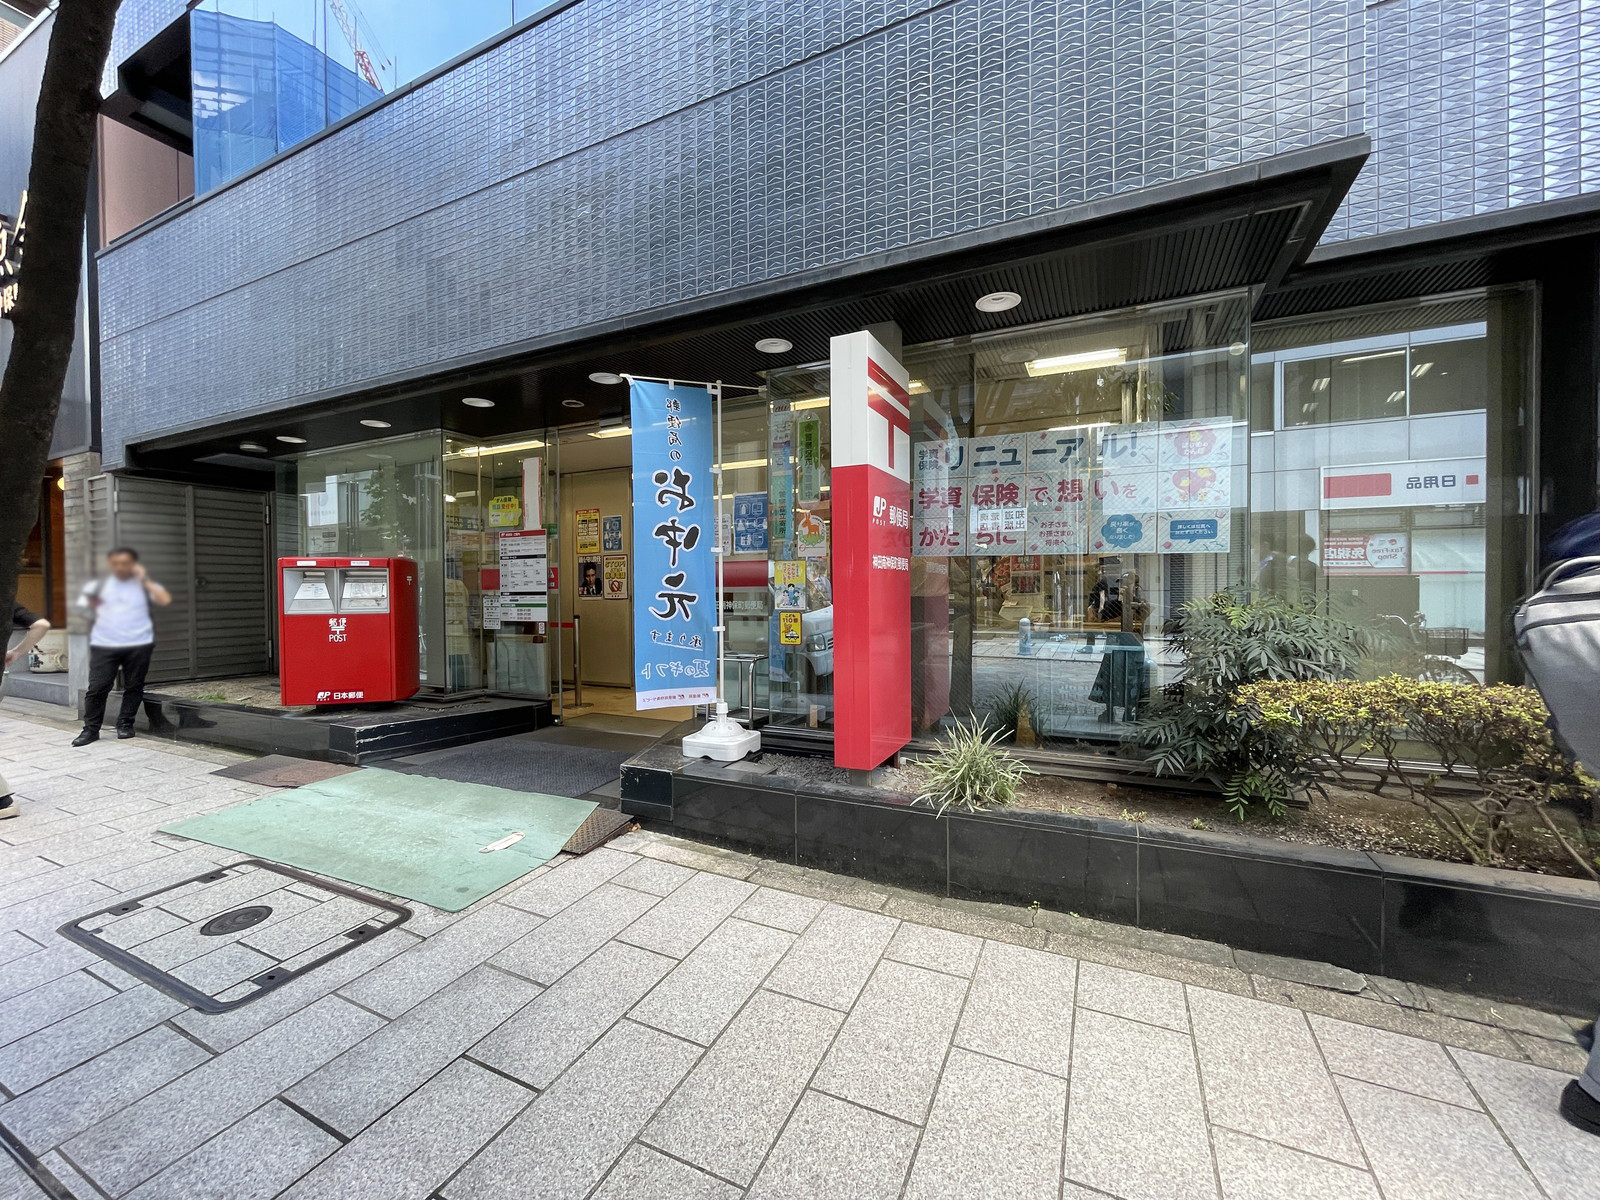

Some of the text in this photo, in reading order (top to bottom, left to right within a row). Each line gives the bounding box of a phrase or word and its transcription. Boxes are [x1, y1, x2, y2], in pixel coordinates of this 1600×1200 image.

[919, 449, 939, 460] 学資
[889, 505, 909, 530] 郵便局
[329, 618, 347, 627] 郵便
[329, 634, 347, 642] POST
[334, 692, 364, 700] 日本郵便
